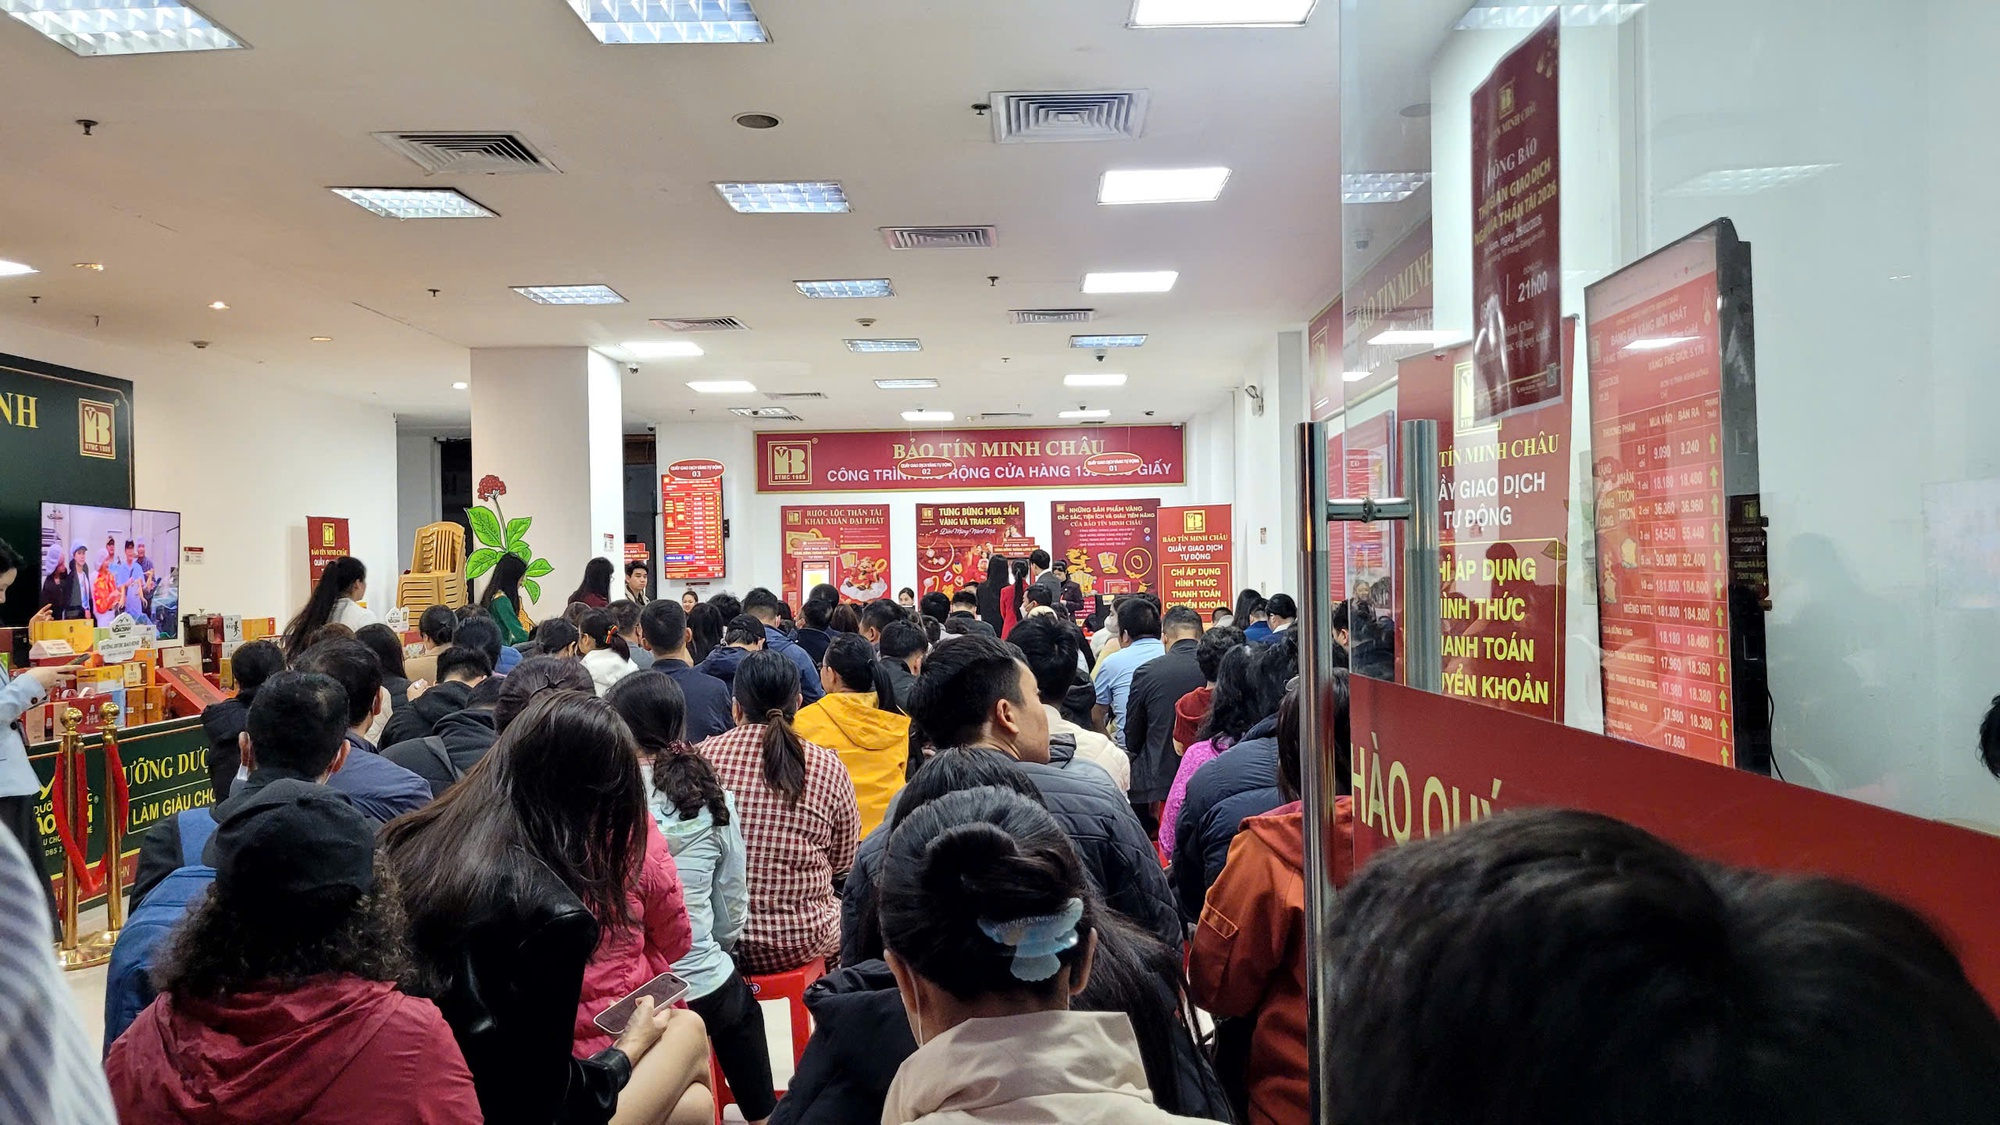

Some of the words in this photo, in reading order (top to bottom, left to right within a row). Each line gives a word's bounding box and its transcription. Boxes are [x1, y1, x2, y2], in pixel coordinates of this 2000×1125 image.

[1518, 137, 1537, 165] BÁO
[1531, 156, 1552, 184] DỊCH
[1538, 179, 1557, 204] 2026
[1377, 275, 1398, 320] TÍN
[1399, 250, 1433, 306] MINH
[1518, 271, 1548, 302] 21h00
[1678, 408, 1691, 421] BÁN
[1691, 407, 1700, 417] RA
[893, 438, 935, 459] BẢO
[939, 439, 977, 458] TÍN
[981, 440, 1041, 457] MINH
[1045, 436, 1104, 456] CHÂU
[1439, 445, 1462, 468] TÍN
[1465, 441, 1507, 465] MINH
[1511, 431, 1560, 458] CHÂU
[1653, 445, 1671, 460] 9.090
[1681, 439, 1700, 455] 9.240
[827, 467, 869, 482] CÔNG
[994, 462, 1025, 479] CỬA
[1029, 462, 1071, 478] HÀNG
[1138, 458, 1172, 476] GIẤY
[1438, 474, 1455, 502] ẦY
[1459, 477, 1498, 499] GIAO
[1503, 471, 1546, 499] DỊCH
[870, 507, 882, 516] TÀI
[985, 507, 1002, 516] MUA
[1125, 504, 1143, 512] VÀNG
[1681, 498, 1704, 513] 36.960
[826, 517, 847, 525] XUÂN
[865, 516, 885, 525] PHÁT
[939, 518, 958, 526] VÀNG
[960, 517, 969, 526] VÀ
[970, 517, 991, 526] TRANG
[993, 516, 1006, 525] SỨC
[1126, 518, 1143, 526] CHÂU
[1443, 509, 1463, 533] TỰ
[1465, 503, 1512, 532] ĐỘNG
[1162, 534, 1176, 543] BẢO
[1178, 534, 1189, 542] TÍN
[1209, 533, 1228, 541] CHÂU
[1655, 527, 1676, 541] 54.540
[1682, 526, 1705, 540] 55.440
[1180, 553, 1190, 562] TỰ
[1190, 552, 1211, 561] ĐỘNG
[1187, 544, 1205, 552] GIAO
[1206, 544, 1223, 553] DỊCH
[1454, 554, 1477, 582] ÁP
[1482, 557, 1537, 586] DỤNG
[1656, 553, 1677, 567] 90.900
[1683, 553, 1706, 567] 92.400
[1170, 567, 1185, 577] CHỈ
[1186, 566, 1196, 576] ÁP
[1198, 567, 1221, 577] DỤNG
[1175, 578, 1194, 587] HÌNH
[1195, 577, 1218, 587] THỨC
[1171, 590, 1198, 598] THANH
[1199, 588, 1221, 598] TOÁN
[1198, 599, 1228, 609] KHOẢN
[1474, 591, 1526, 622] THỨC
[1441, 635, 1478, 659] ANH
[1483, 631, 1534, 662] TOÁN
[1481, 672, 1549, 705] KHOẢN
[122, 757, 173, 788] ƯỠNG
[1351, 731, 1412, 846] HÀO
[132, 802, 160, 826] LÀM
[162, 793, 191, 817] GIÀU
